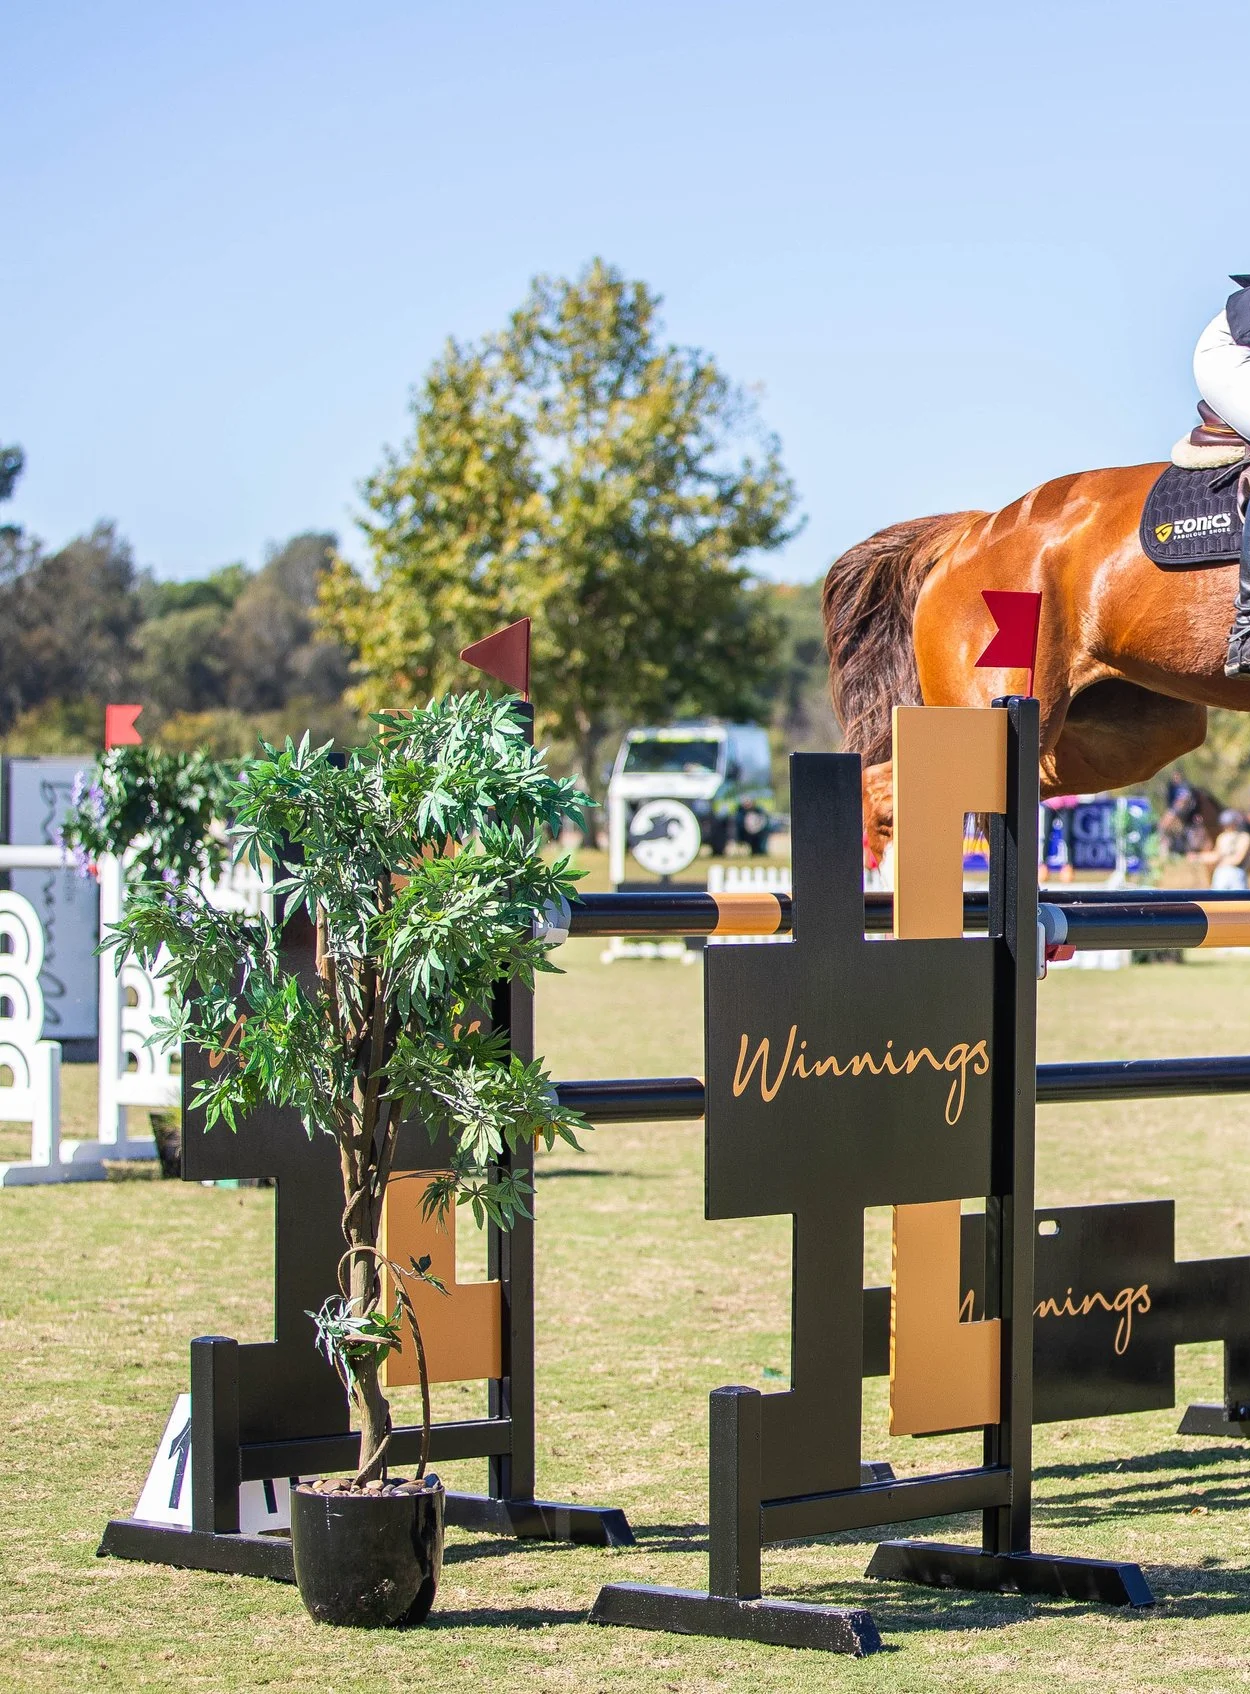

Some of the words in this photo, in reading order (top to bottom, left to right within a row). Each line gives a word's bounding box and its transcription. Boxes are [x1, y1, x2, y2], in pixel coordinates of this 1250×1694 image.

[1173, 531, 1206, 540] FABULOUS
[1209, 528, 1231, 536] SHOES
[733, 1025, 990, 1125] Winnings
[959, 1284, 1151, 1355] nings
